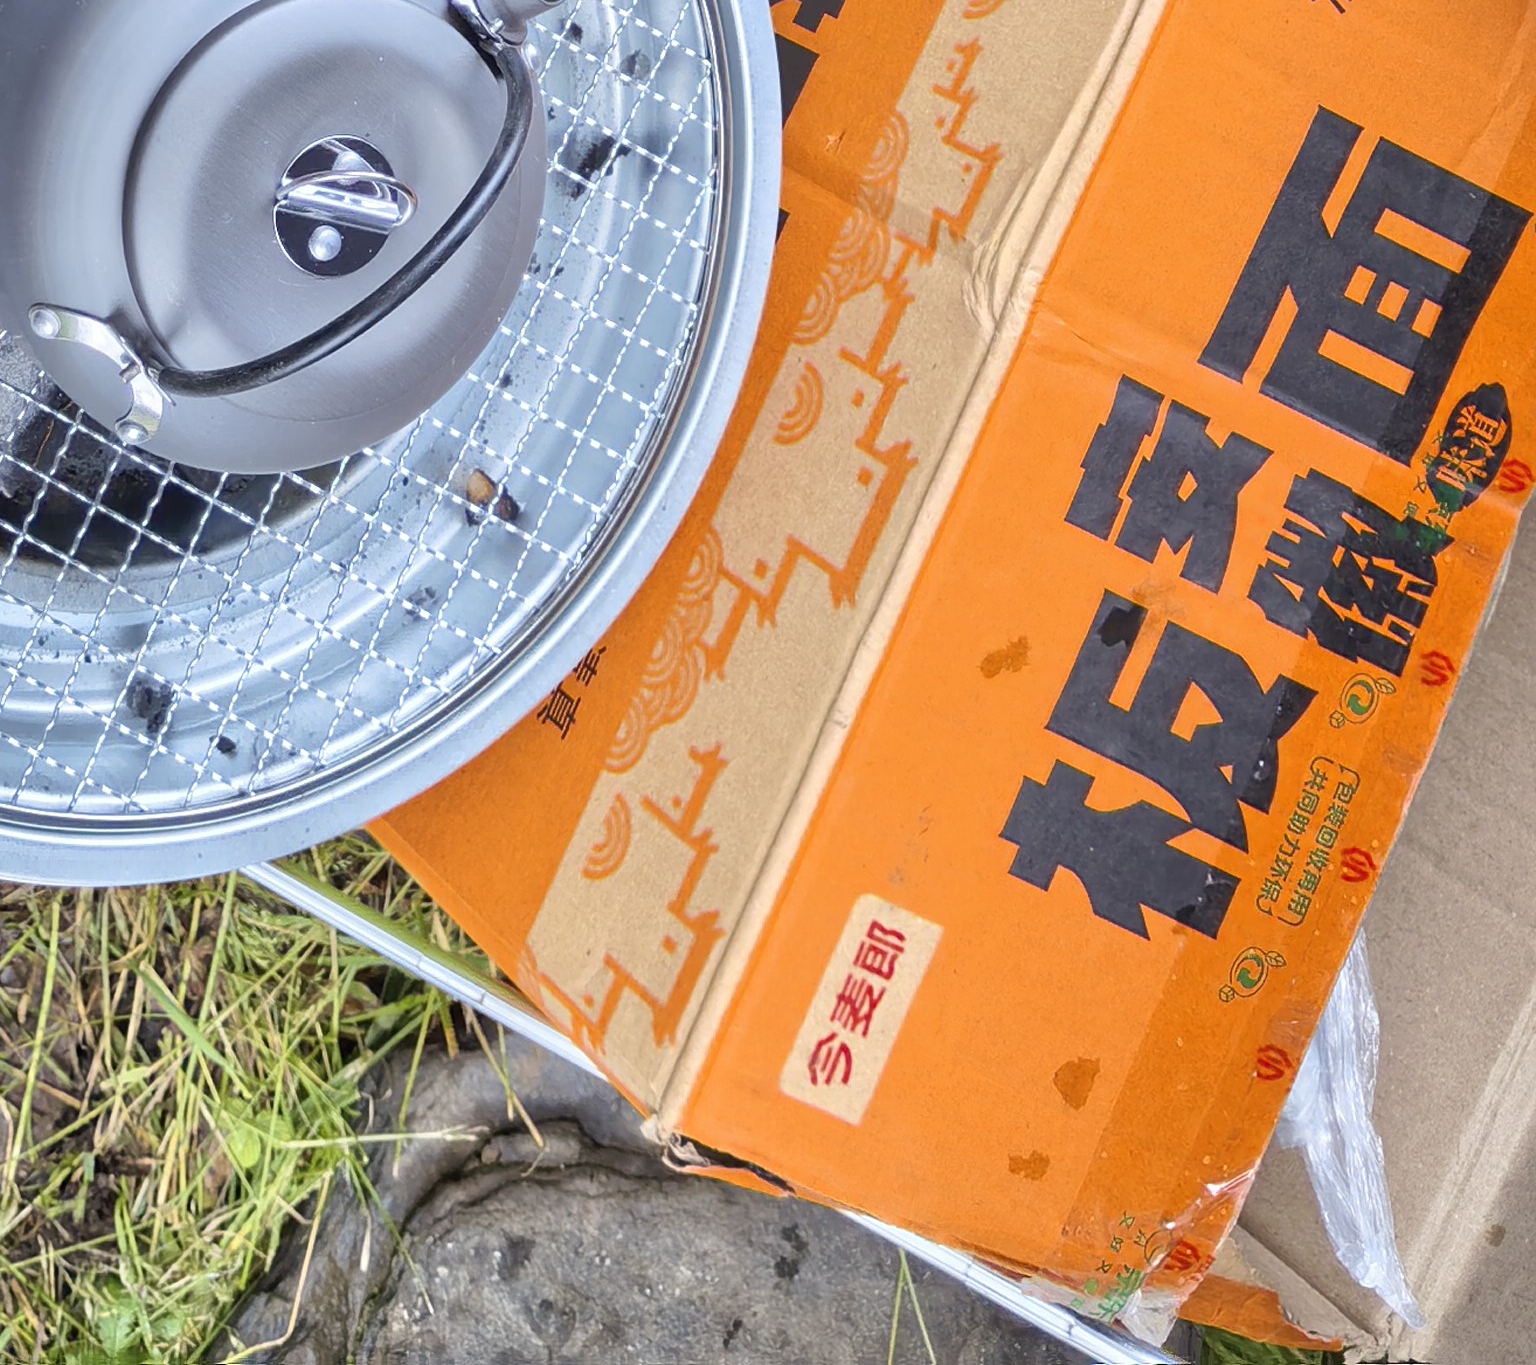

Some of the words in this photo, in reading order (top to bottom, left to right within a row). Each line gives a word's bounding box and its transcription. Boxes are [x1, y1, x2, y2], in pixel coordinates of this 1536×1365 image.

[1435, 404, 1508, 493] 味道
[1261, 769, 1328, 903] 共同助力环保
[1287, 781, 1356, 917] 包装回收再用
[807, 917, 909, 1089] 今麦郎
